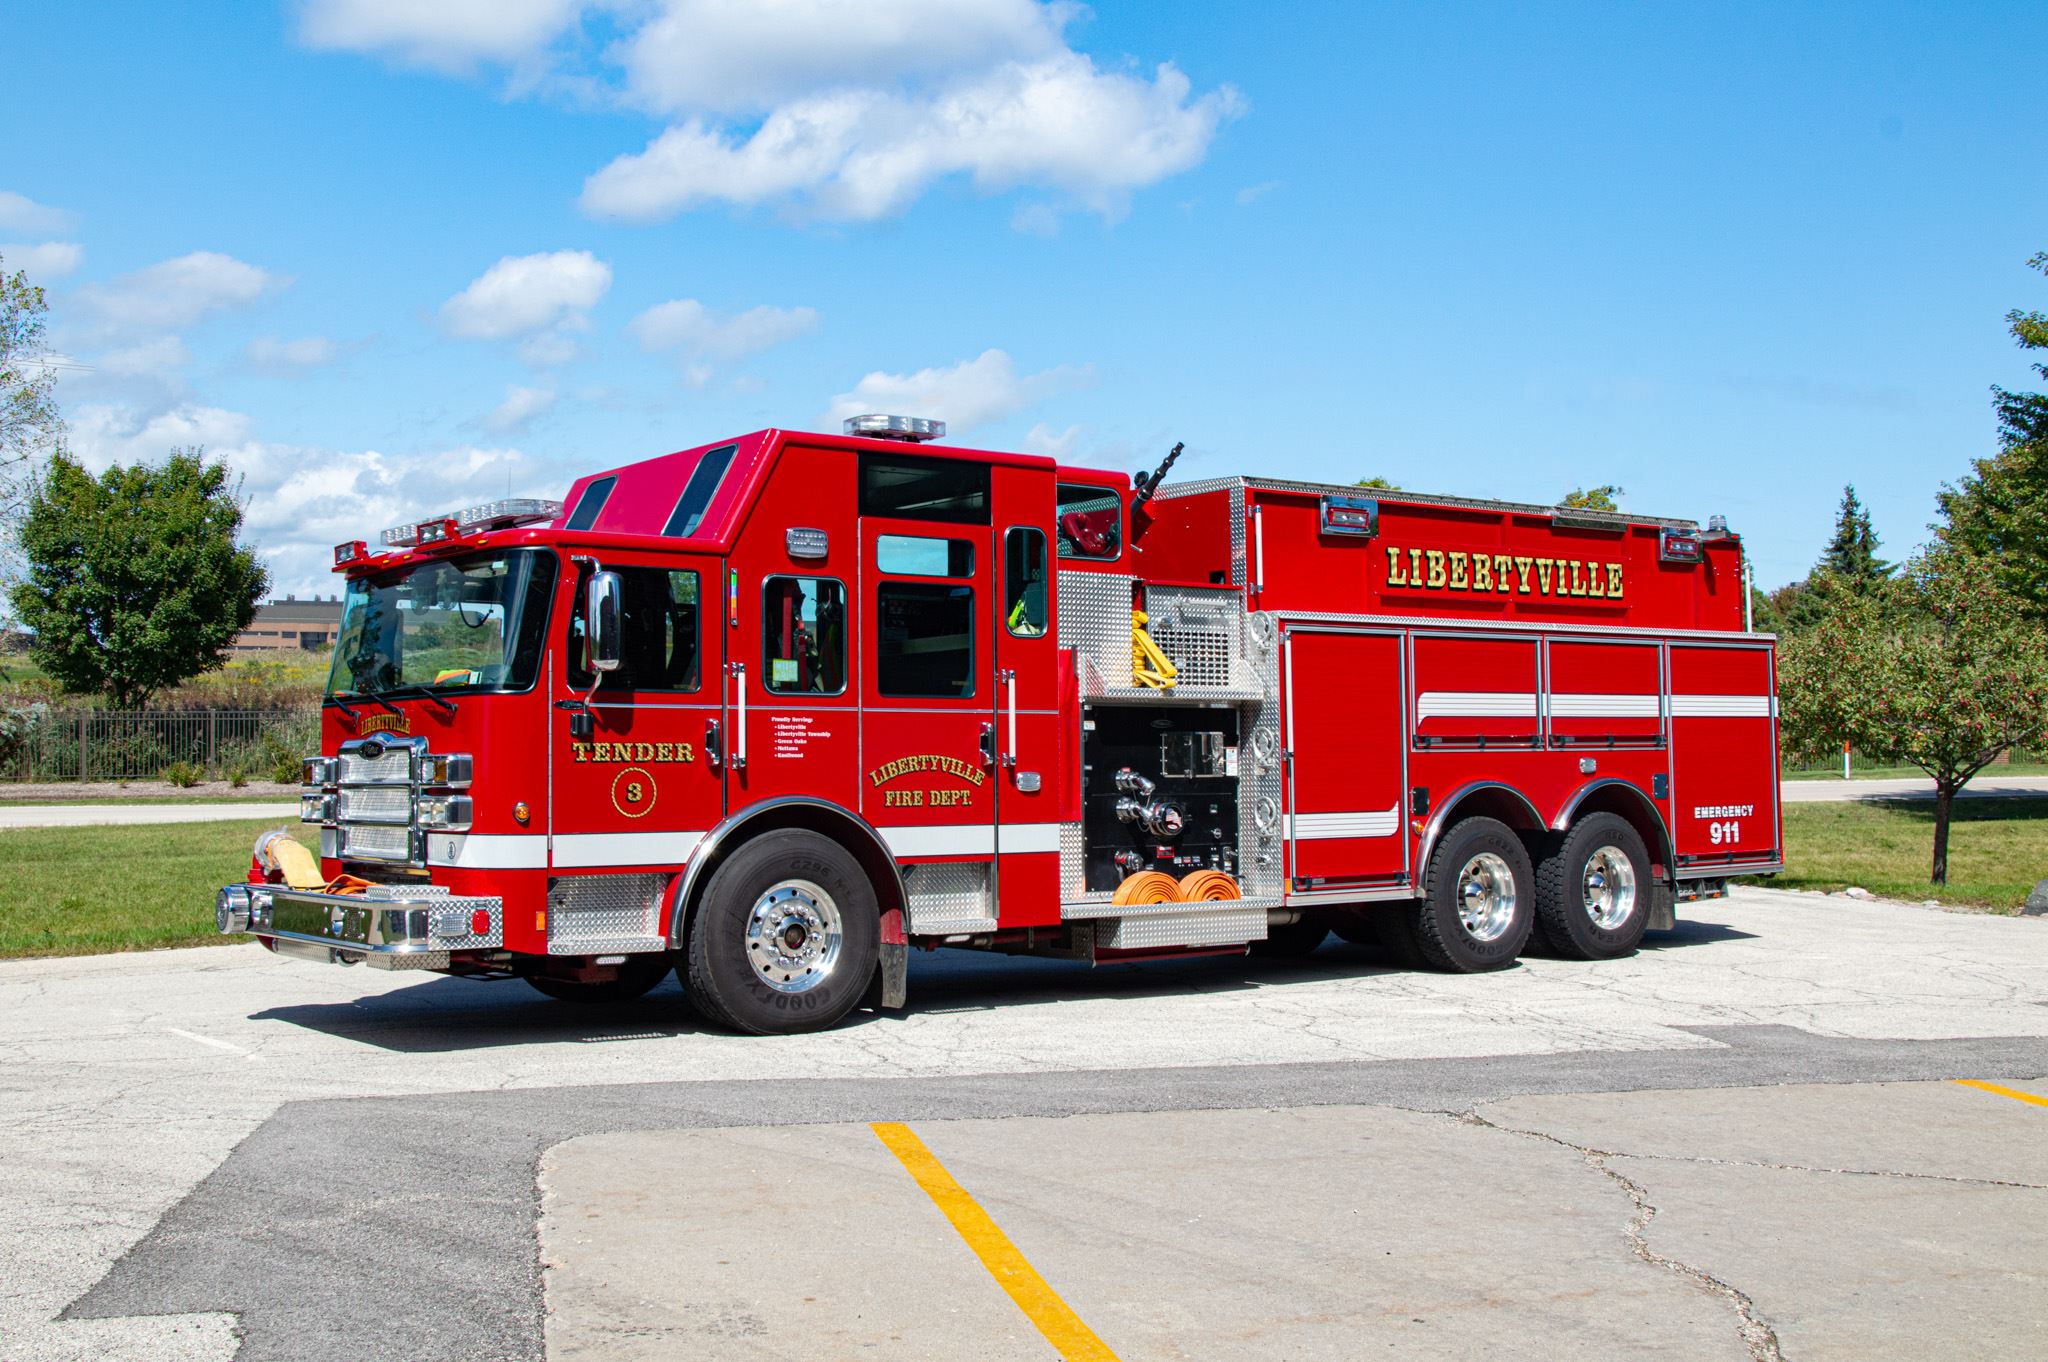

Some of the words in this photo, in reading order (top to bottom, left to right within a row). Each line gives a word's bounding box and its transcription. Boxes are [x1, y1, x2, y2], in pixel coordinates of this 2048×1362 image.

[1387, 546, 1624, 599] LIBERTYVILLE
[361, 713, 411, 737] LIBERTYVILLE
[571, 742, 696, 763] TENDER
[869, 754, 986, 788] LIBERTYVILLE
[626, 782, 643, 802] 3
[884, 789, 923, 807] FIRE
[929, 789, 973, 806] DEPT.
[1693, 804, 1754, 819] EMERGENCY
[1709, 820, 1740, 845] 911
